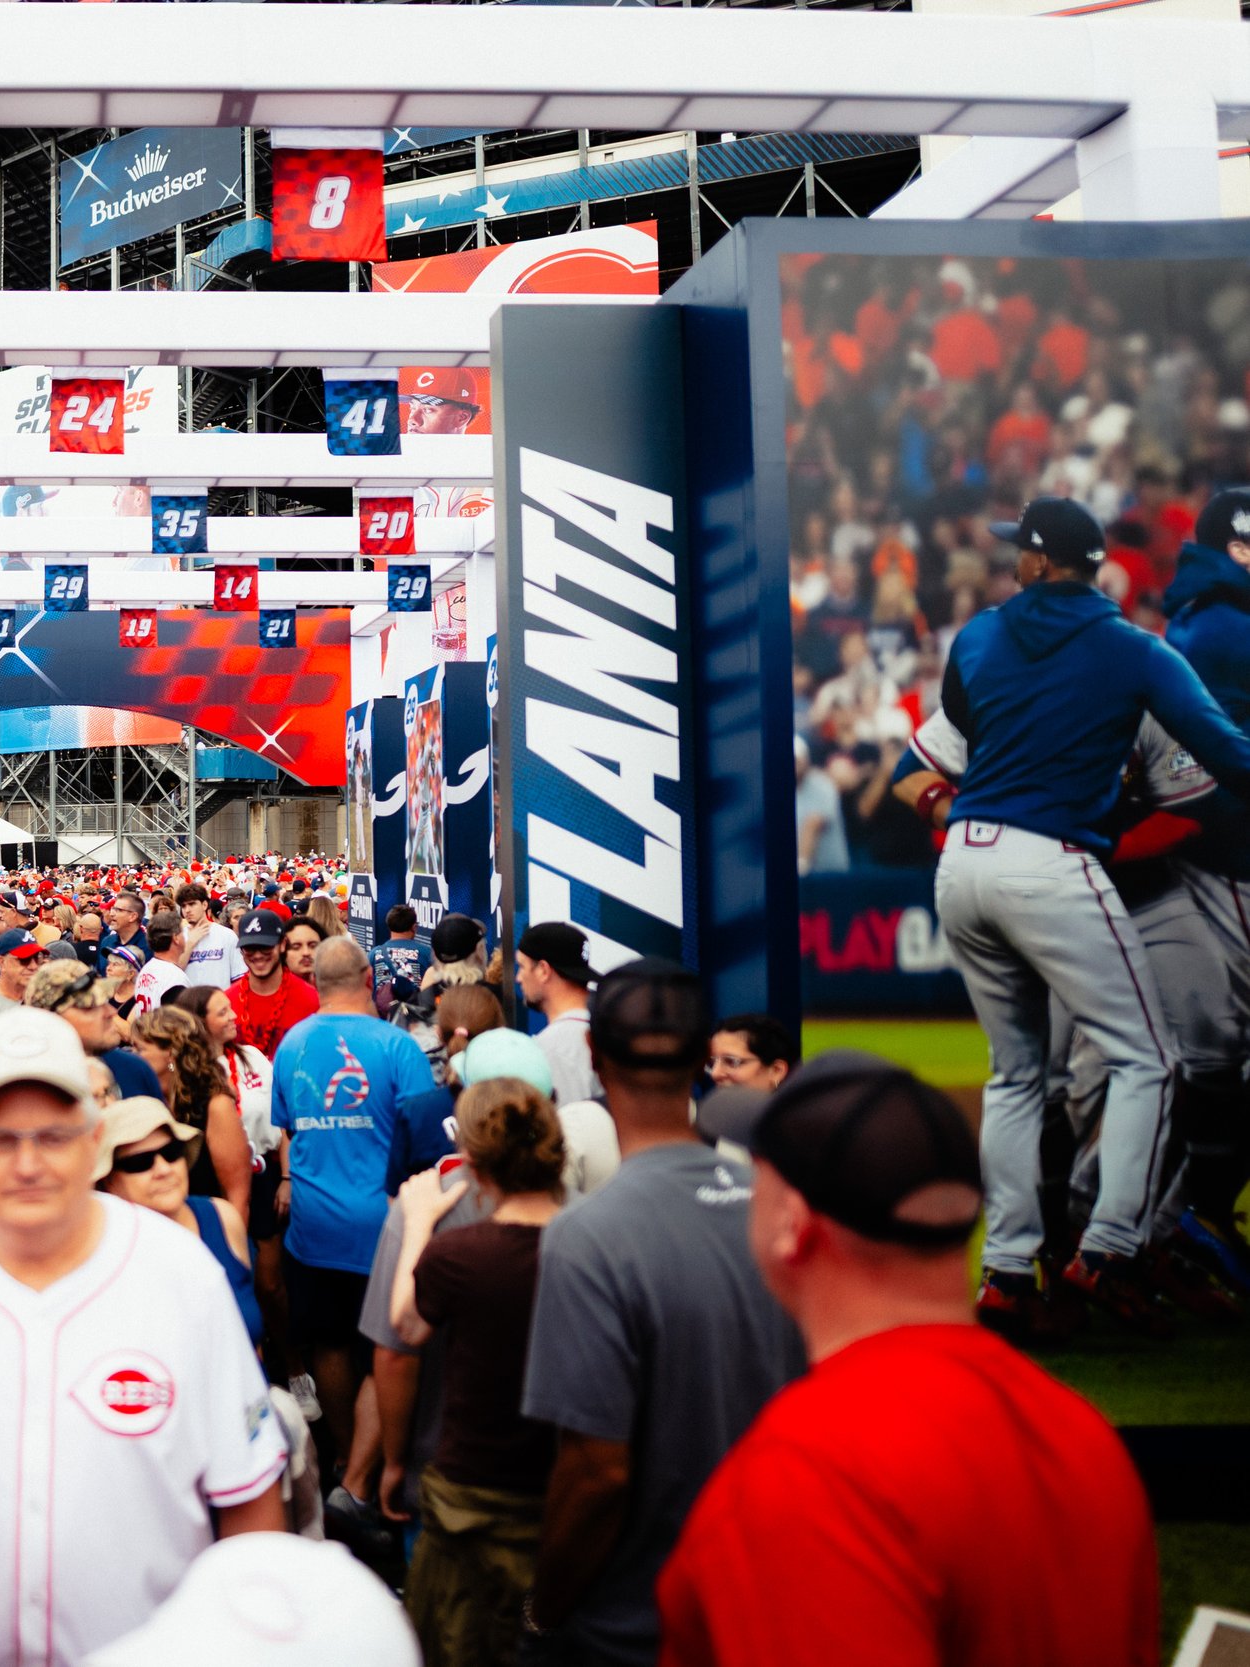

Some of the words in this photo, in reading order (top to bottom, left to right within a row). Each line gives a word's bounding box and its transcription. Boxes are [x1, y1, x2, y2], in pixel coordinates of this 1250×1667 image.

[90, 167, 207, 227] Budweiser
[308, 175, 351, 231] 8
[58, 396, 117, 433] 24
[341, 398, 387, 435] 41
[159, 509, 199, 538] 35
[367, 511, 409, 539] 20
[50, 576, 84, 598] 29
[222, 576, 252, 599] 14
[394, 576, 427, 599] 29
[125, 618, 152, 637] 19
[266, 618, 291, 638] 21
[405, 699, 416, 726] 29
[519, 446, 684, 978] TLANTA
[350, 894, 372, 920] SPAHN
[188, 948, 224, 963] angers
